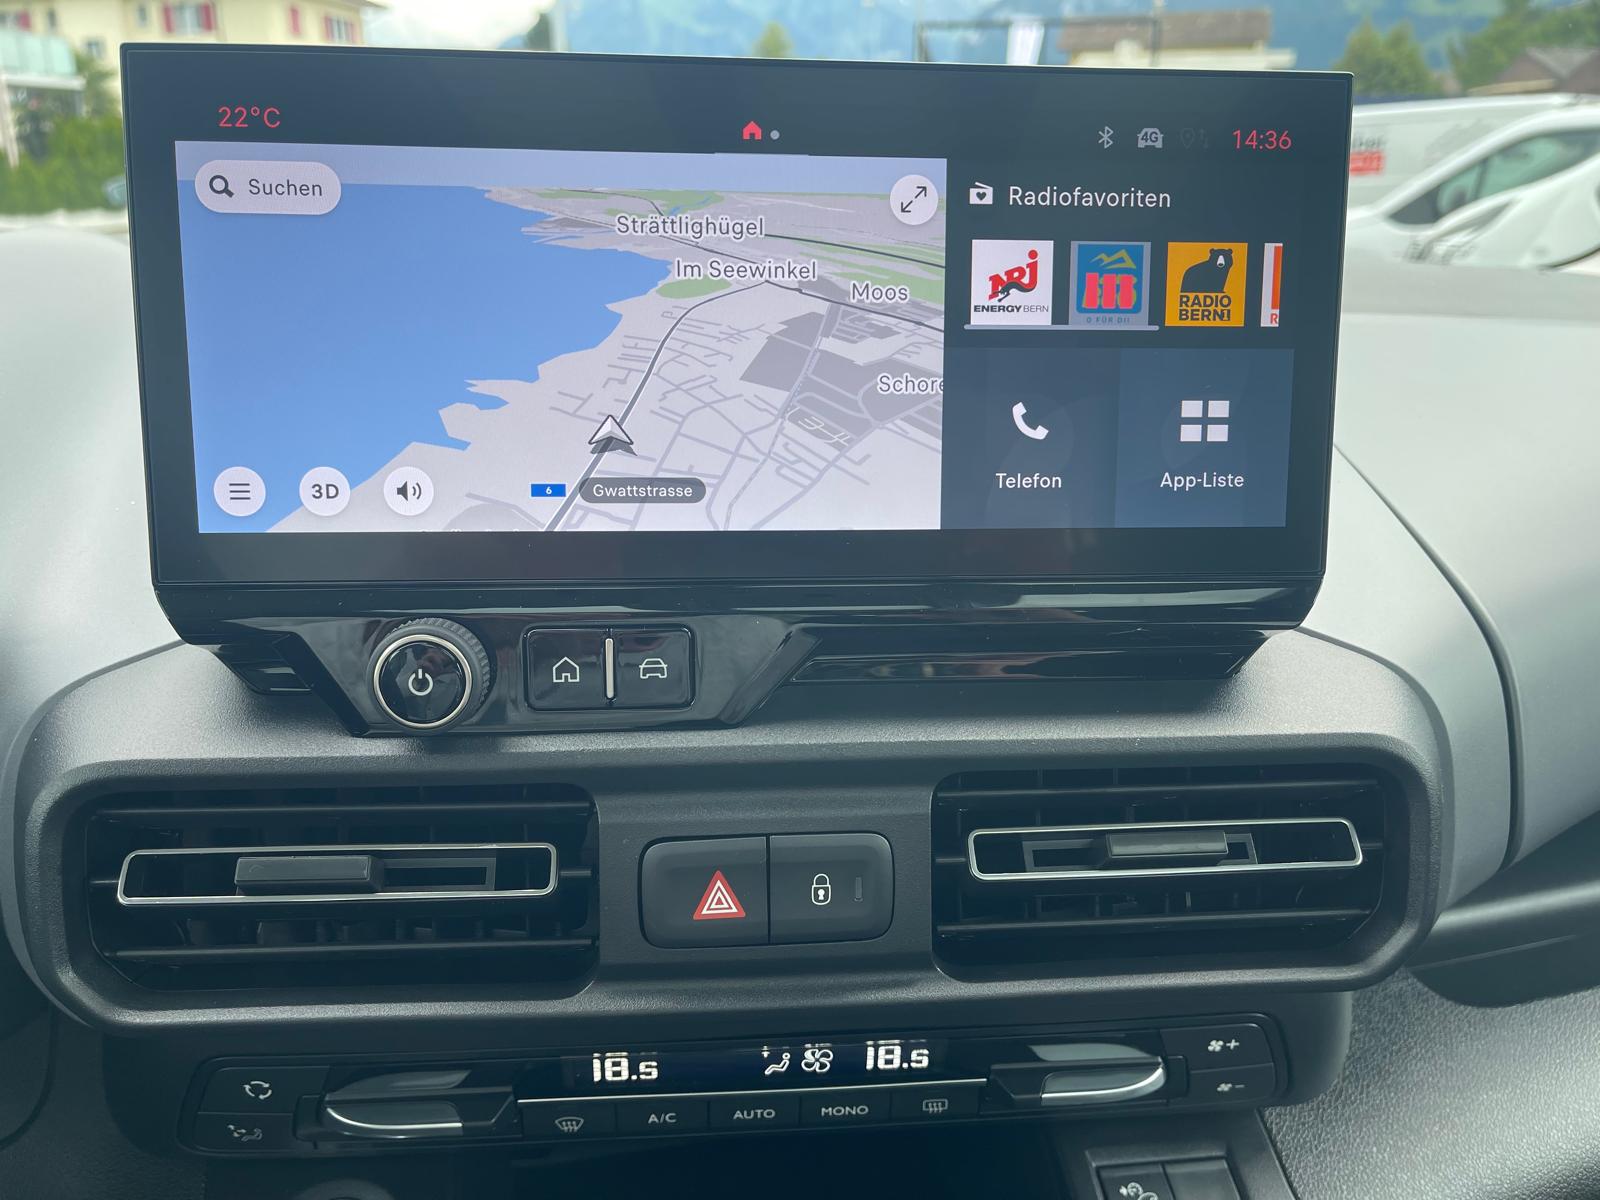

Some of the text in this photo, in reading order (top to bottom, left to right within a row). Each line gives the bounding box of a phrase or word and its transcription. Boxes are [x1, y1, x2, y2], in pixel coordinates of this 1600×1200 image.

[218, 106, 281, 128] 22°C
[1140, 131, 1159, 143] 4G
[1232, 129, 1292, 150] 14:36
[248, 178, 323, 197] Suchen
[1008, 186, 1171, 208] Radiofavoriten
[616, 214, 765, 240] Strättlighügel
[675, 259, 818, 280] Im Seewinkel
[851, 282, 908, 302] Moos
[973, 304, 1049, 313] ENERGY BERN
[1179, 295, 1232, 308] RADIO
[995, 472, 1063, 489] Telefon
[1159, 471, 1245, 490] App-Liste
[311, 483, 339, 500] 3D
[545, 486, 552, 495] 6
[592, 483, 693, 499] Gwattstrasse
[865, 1044, 930, 1070] 18.5
[591, 1057, 659, 1082] 18.5
[647, 1112, 678, 1124] A/C
[732, 1109, 776, 1121] AUTO
[820, 1105, 869, 1117] MONO
